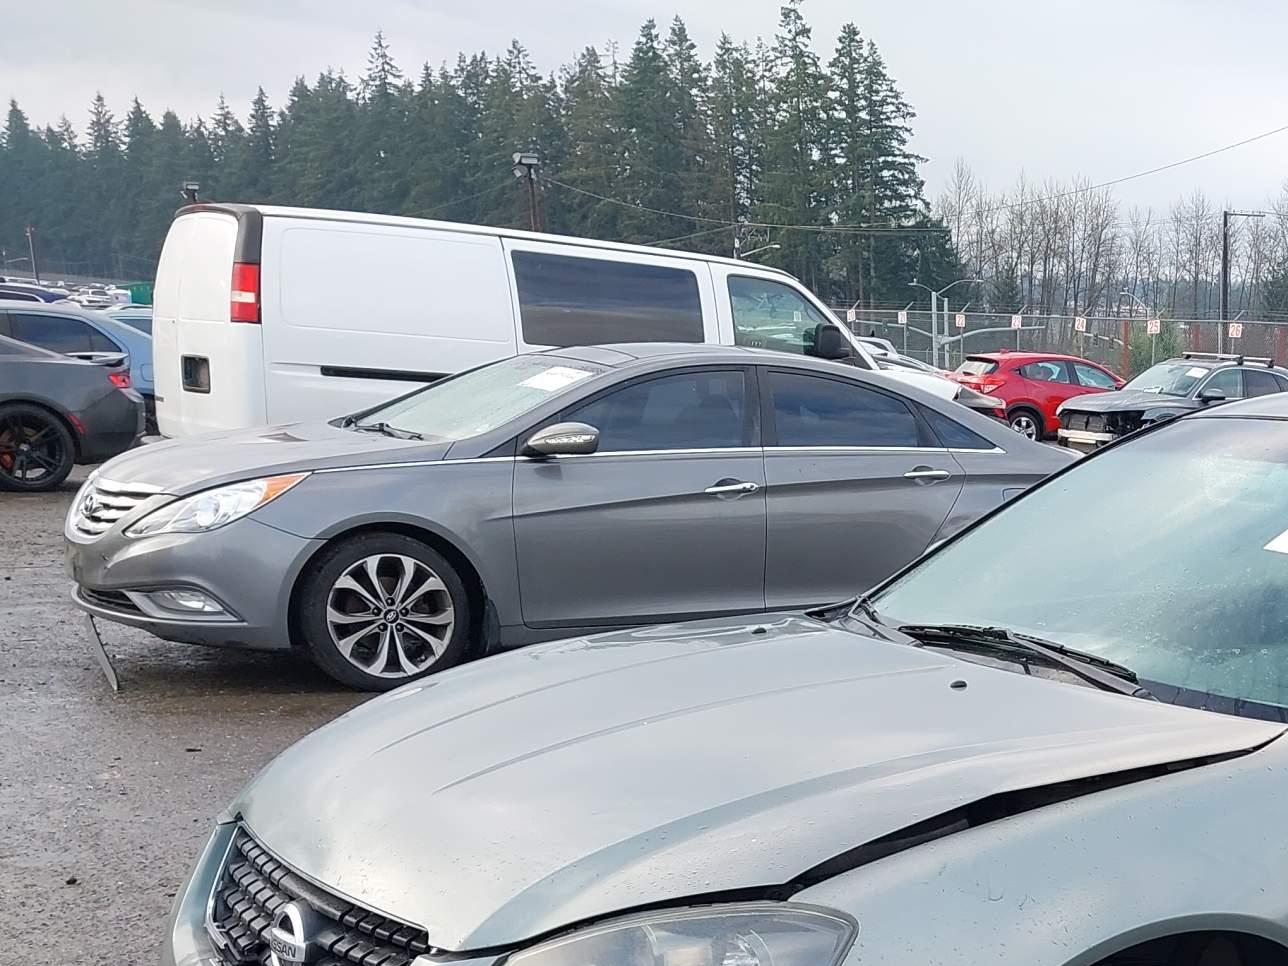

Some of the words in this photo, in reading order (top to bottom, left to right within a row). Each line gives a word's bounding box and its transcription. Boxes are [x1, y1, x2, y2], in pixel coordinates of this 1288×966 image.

[1076, 318, 1085, 329] 24
[1149, 321, 1159, 331] 25
[1231, 325, 1241, 336] 26
